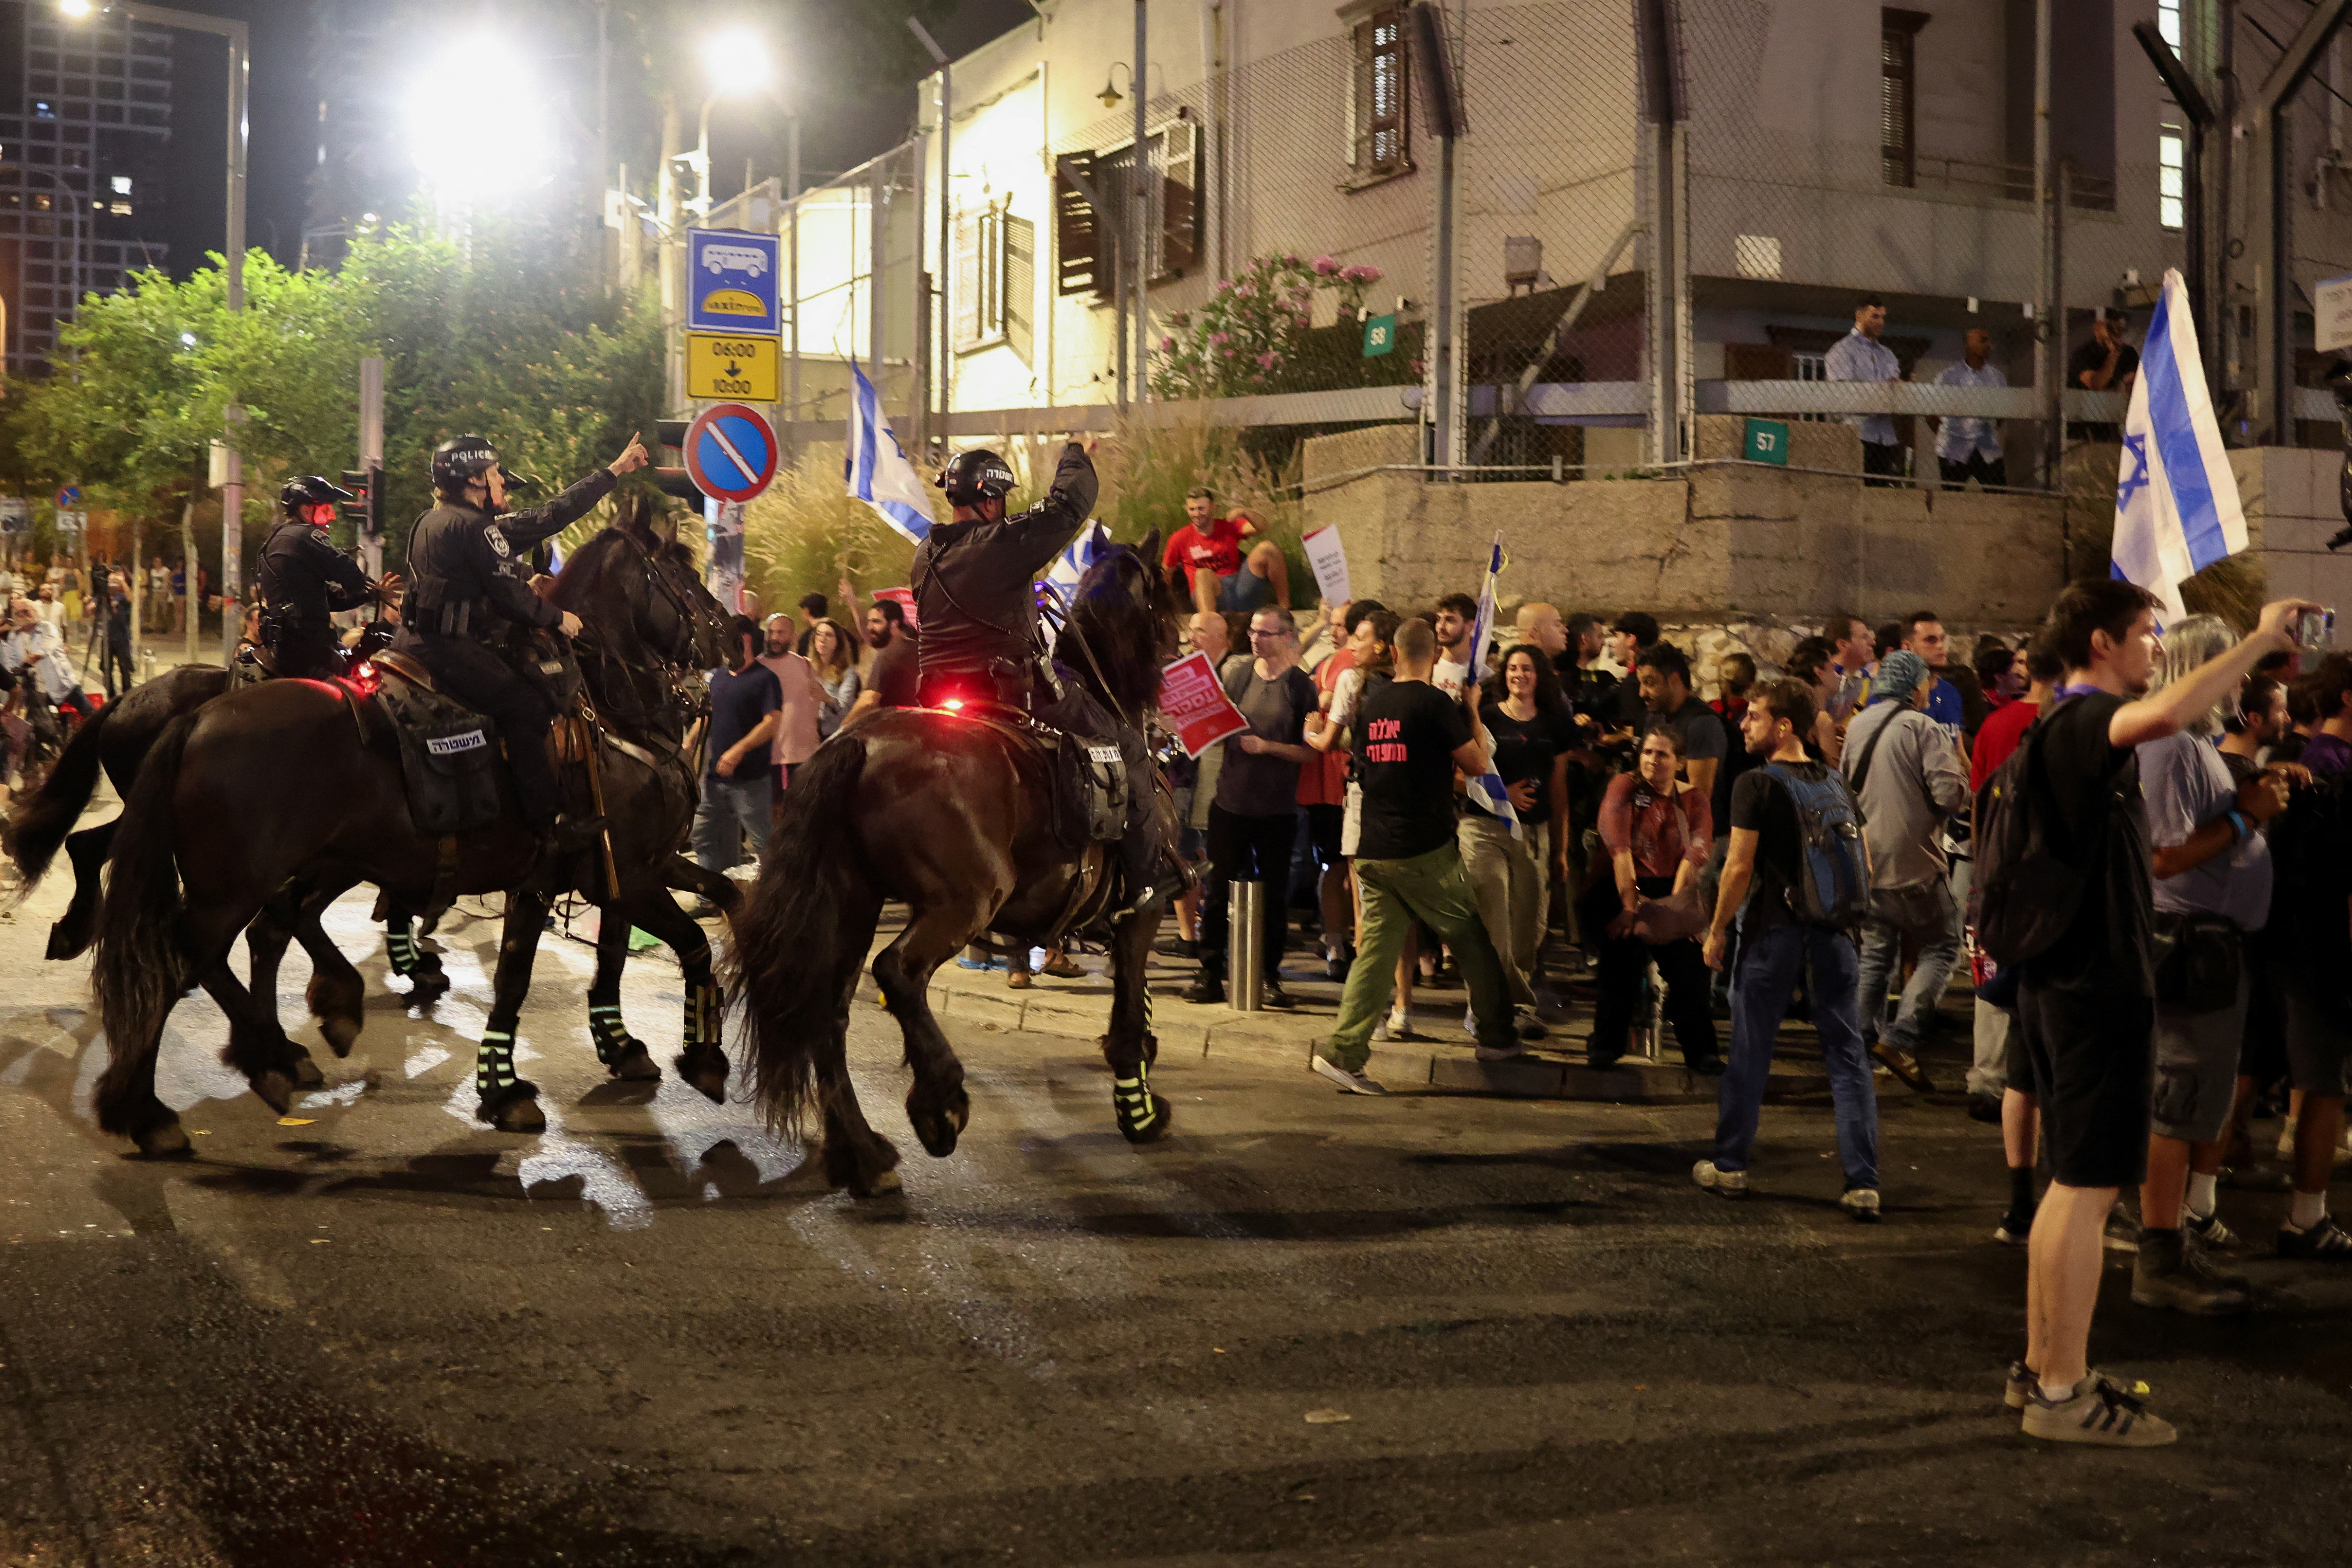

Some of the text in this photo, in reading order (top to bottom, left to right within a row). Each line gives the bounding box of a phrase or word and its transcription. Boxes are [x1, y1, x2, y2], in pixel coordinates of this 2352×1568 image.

[1756, 432, 1776, 451] 57
[451, 449, 494, 463] POLICE
[432, 735, 481, 752] משטרה
